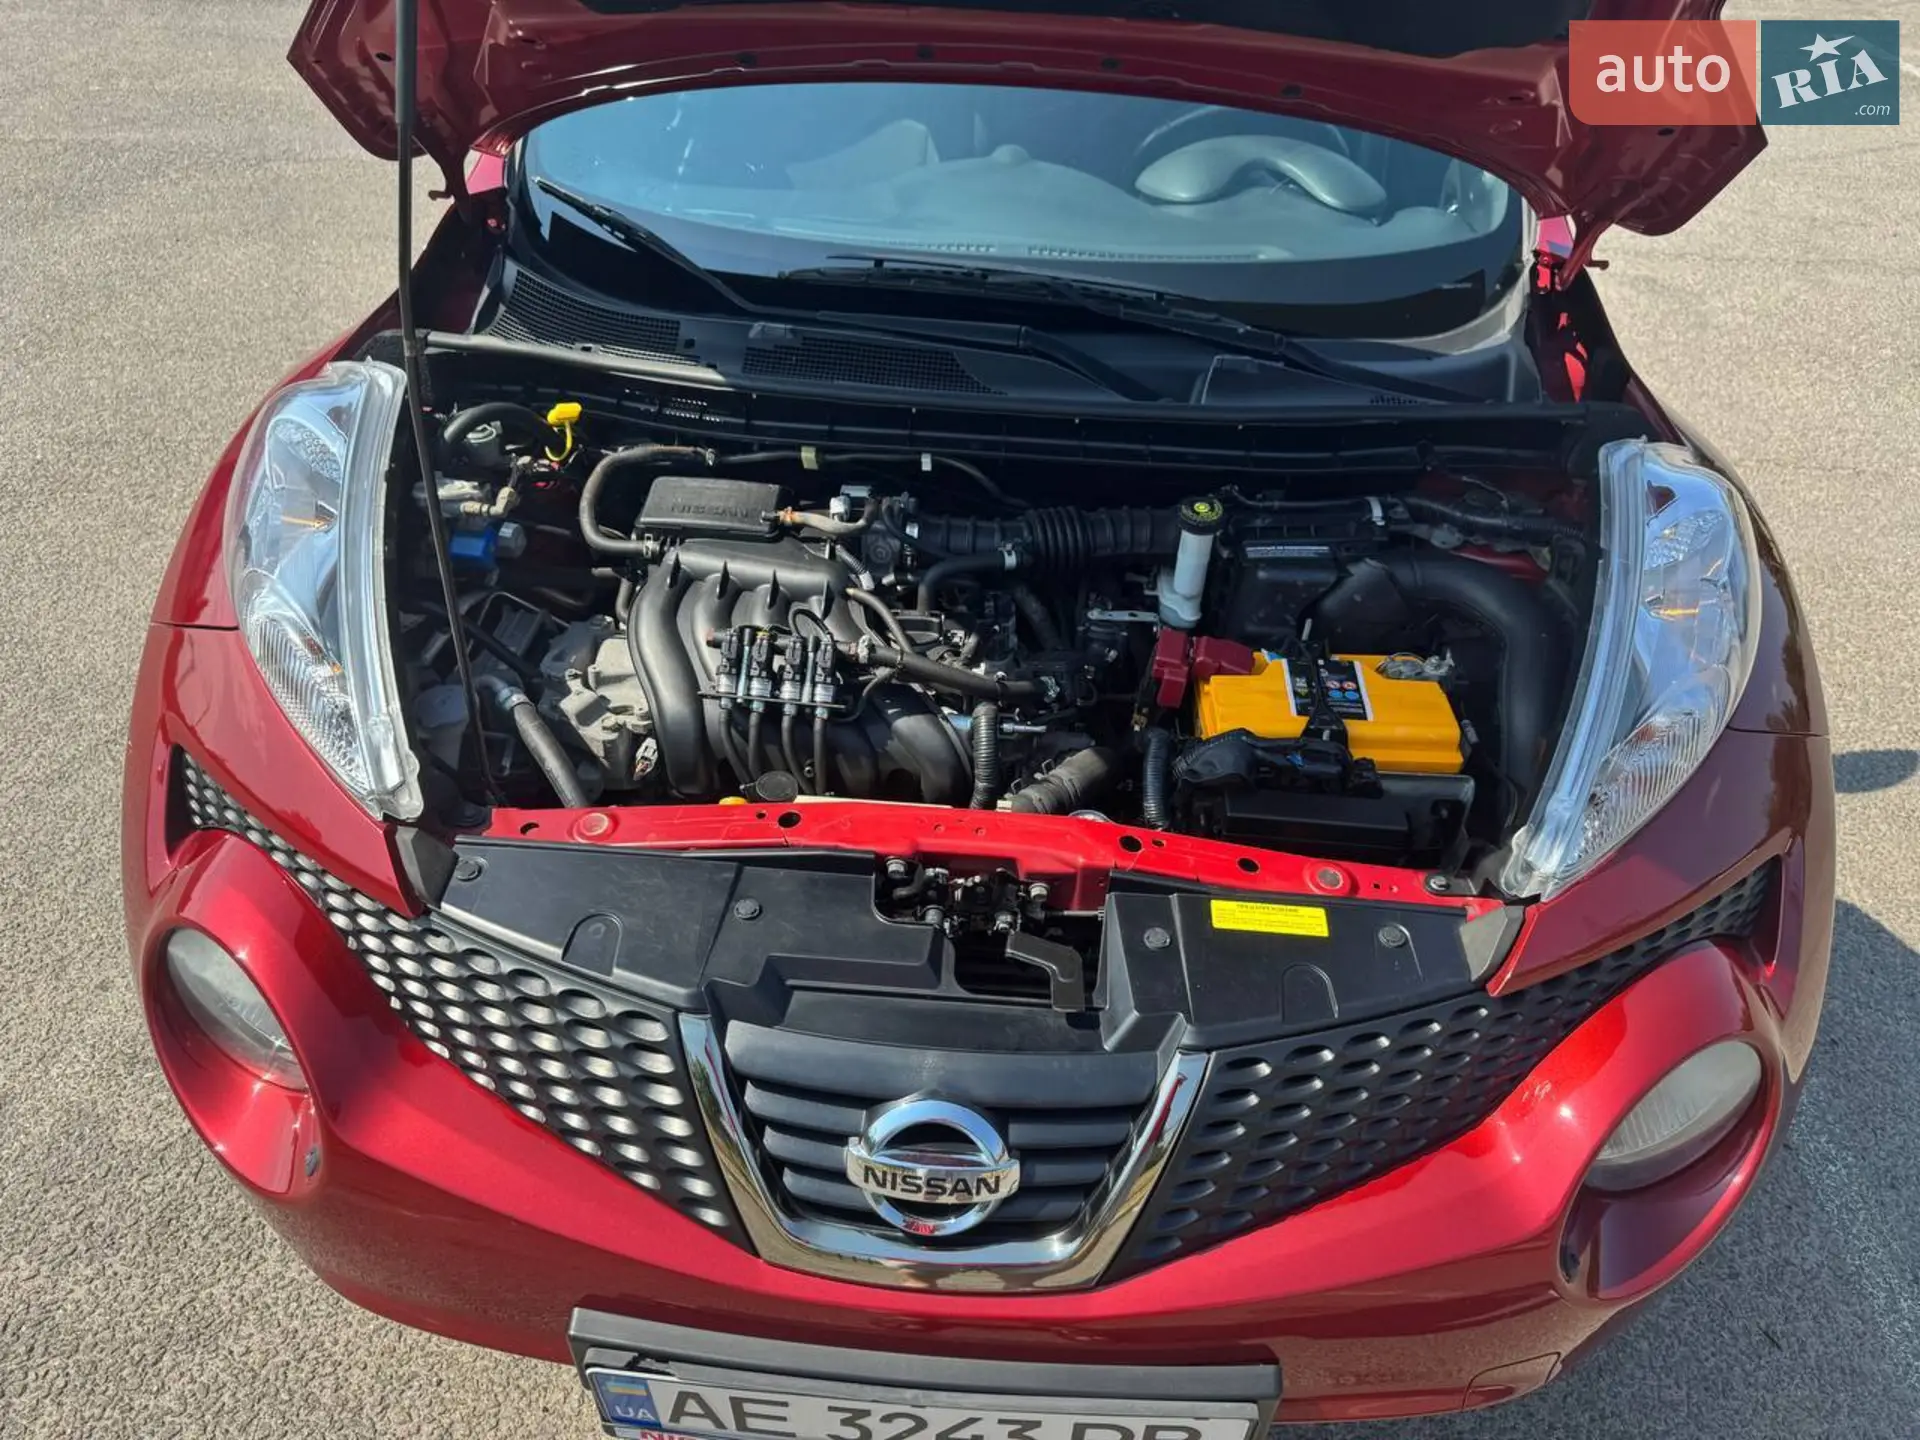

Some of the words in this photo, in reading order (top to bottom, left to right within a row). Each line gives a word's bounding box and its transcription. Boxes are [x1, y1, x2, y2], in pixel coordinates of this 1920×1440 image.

[863, 1164, 1001, 1197] NISSAN
[614, 1404, 655, 1420] UA
[668, 1390, 797, 1438] AE
